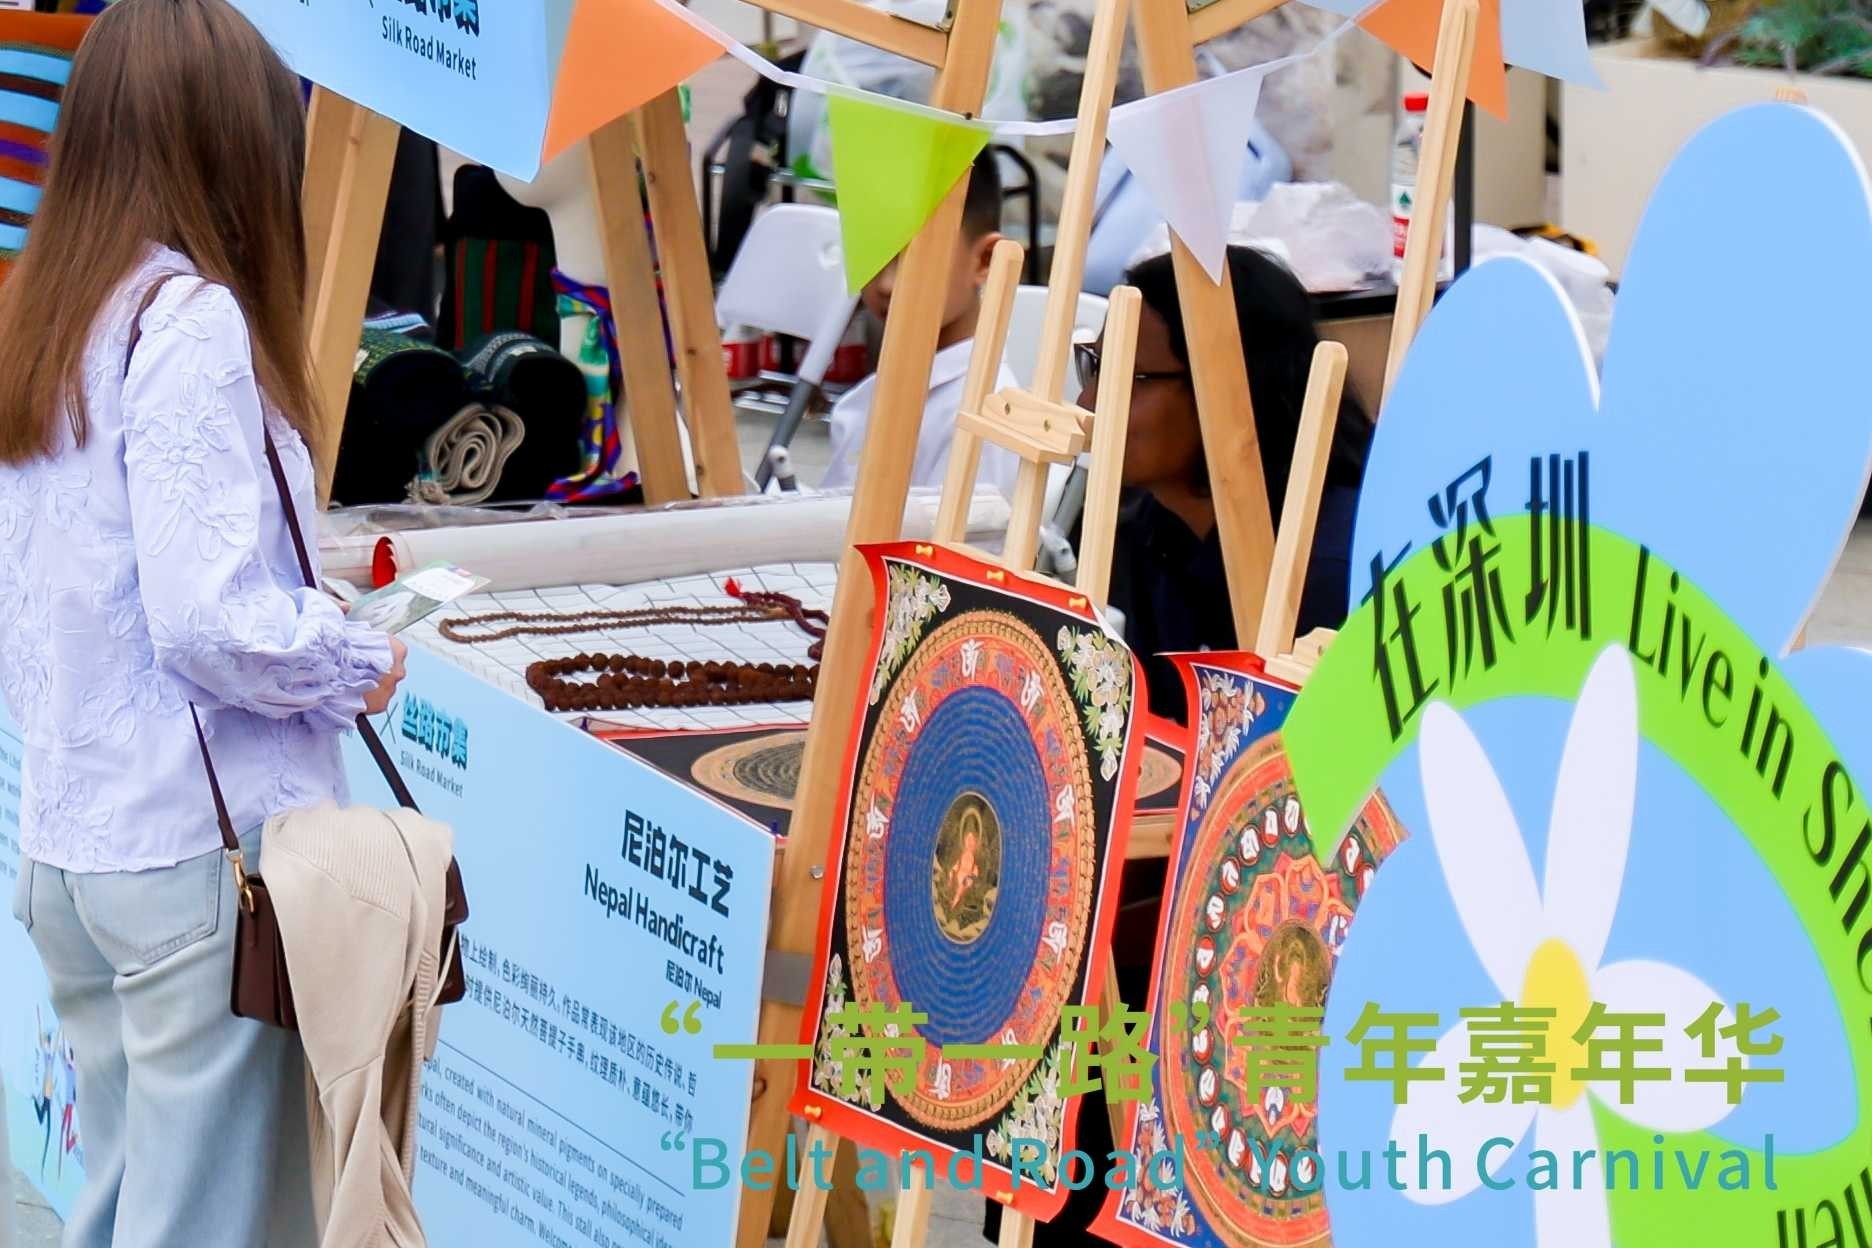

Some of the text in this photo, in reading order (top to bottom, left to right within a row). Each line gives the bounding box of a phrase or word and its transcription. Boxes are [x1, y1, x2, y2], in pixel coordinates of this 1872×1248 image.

[381, 15, 477, 81] Silk Road Market
[1361, 450, 1593, 744] 在深圳
[1628, 544, 1735, 729] Live
[1740, 656, 1795, 800] in
[400, 750, 463, 799] Silk Road Market
[402, 691, 468, 771] 丝路市集
[622, 809, 733, 918] 尼泊尔工艺
[585, 863, 724, 975] Nepal Handicraft
[666, 959, 721, 1010] 尼泊尔 Nepal
[420, 1145, 447, 1178] texture
[449, 1167, 464, 1189] and
[466, 1178, 509, 1218] meaningful
[422, 1084, 433, 1104] rks
[434, 1091, 455, 1118] often
[457, 1103, 481, 1135] depict
[483, 1120, 496, 1144] the
[530, 1150, 566, 1189] historical
[600, 1197, 653, 1245] philosophical
[439, 1125, 484, 1169] significance
[486, 1158, 501, 1180] and
[503, 1168, 530, 1198] artistic
[558, 1199, 572, 1225] This
[574, 1212, 592, 1238] stall
[445, 1067, 473, 1097] created
[477, 1086, 494, 1110] with
[497, 1100, 525, 1130] natural
[527, 1118, 556, 1150] mineral
[558, 1138, 595, 1175] pigments
[597, 1164, 608, 1183] on
[610, 1172, 644, 1211] specially
[646, 1195, 683, 1231] prepared
